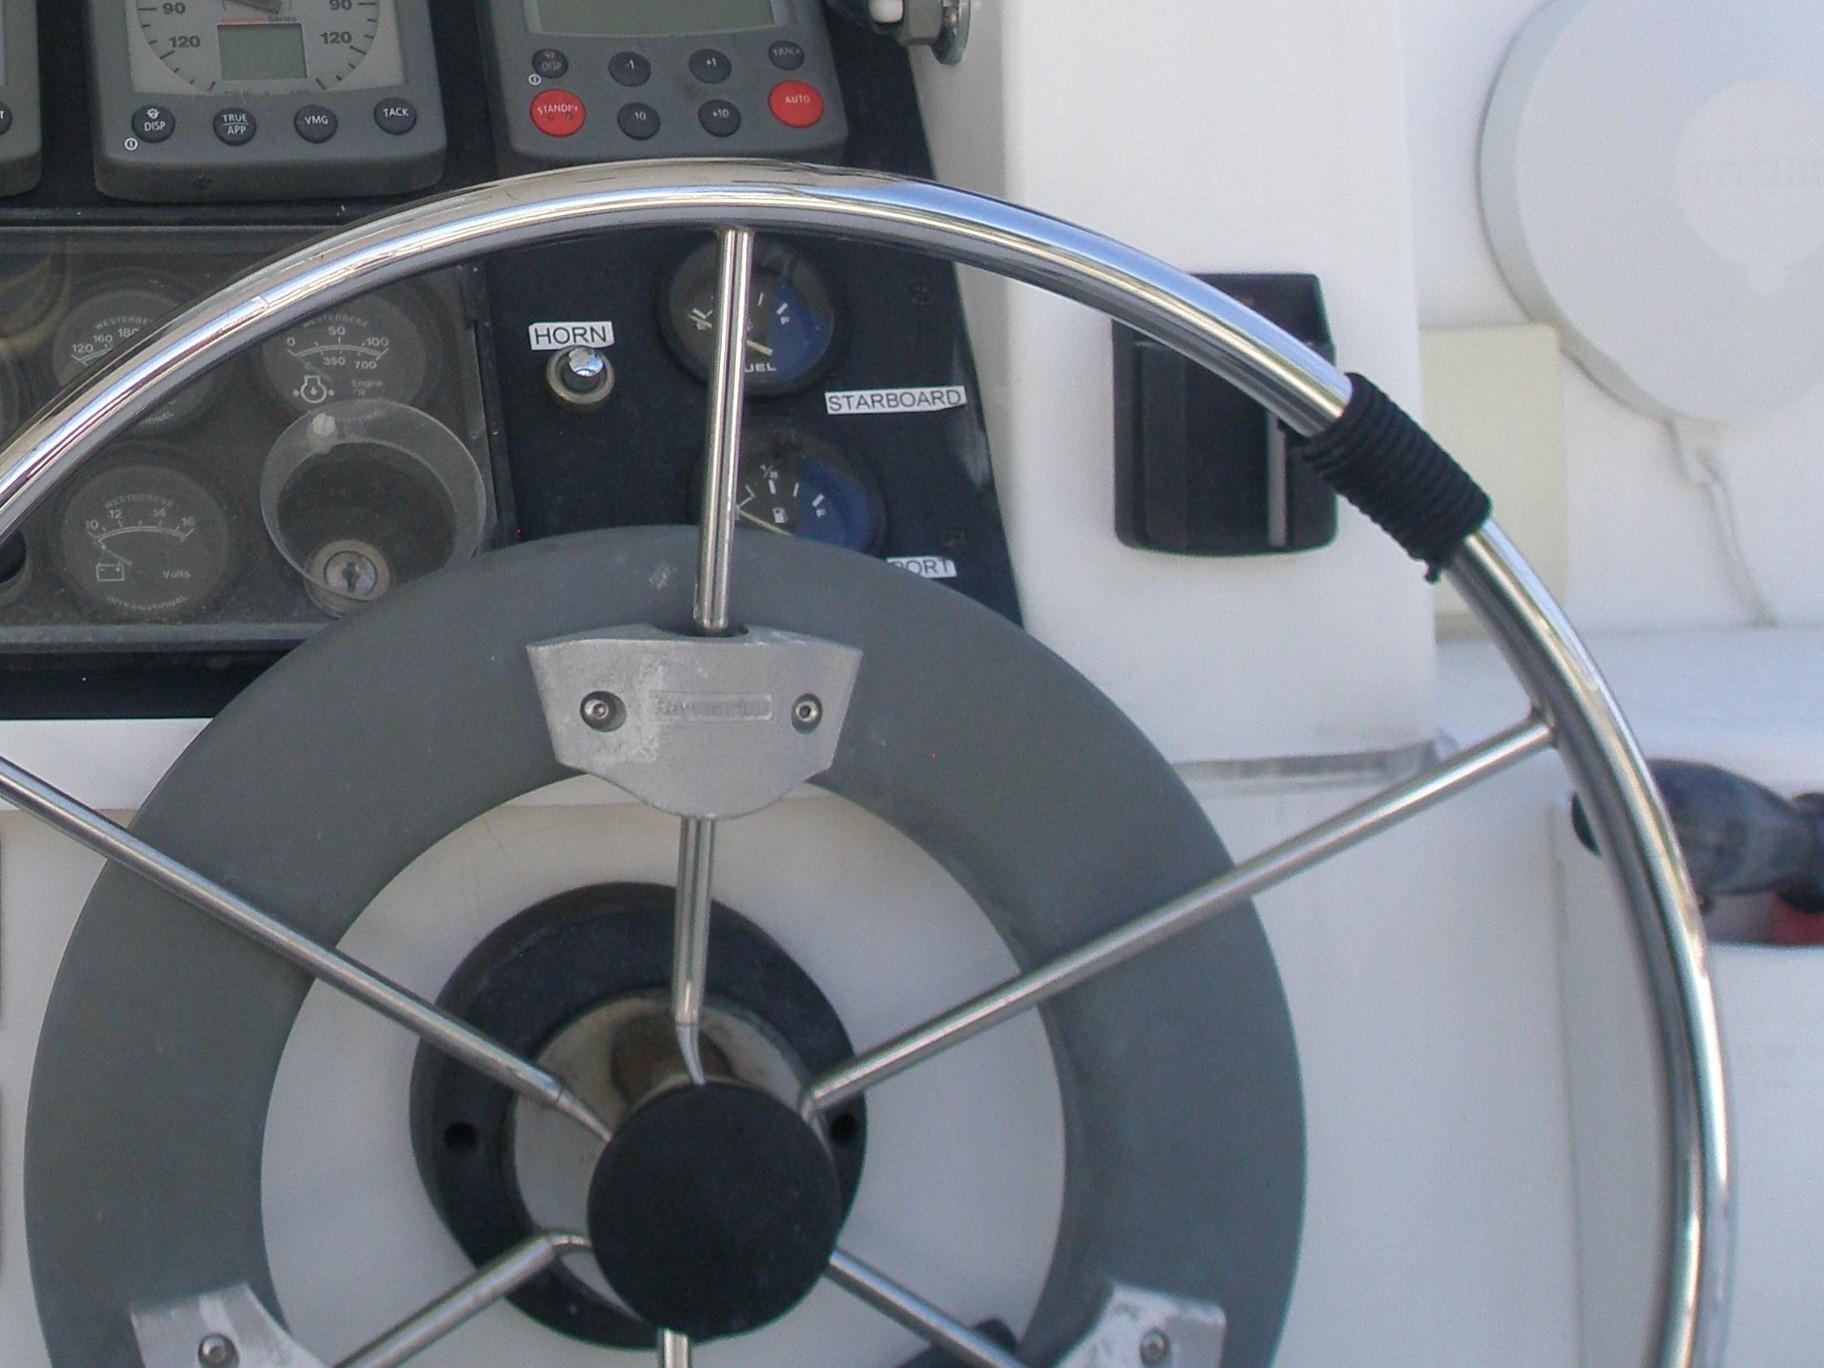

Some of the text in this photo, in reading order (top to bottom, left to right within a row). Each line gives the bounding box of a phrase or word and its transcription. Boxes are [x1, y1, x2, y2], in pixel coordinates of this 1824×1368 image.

[162, 2, 186, 14] 90
[168, 35, 201, 48] 120
[320, 31, 352, 44] 120
[785, 94, 810, 104] AUTO
[383, 107, 409, 117] TACK
[223, 114, 248, 123] TRUE
[304, 115, 329, 125] VMG
[144, 120, 166, 131] DISP
[227, 125, 247, 135] APP
[328, 325, 346, 336] 50
[535, 324, 608, 346] HORN
[93, 334, 113, 343] 160
[286, 336, 296, 347] 0
[366, 336, 389, 347] 100
[72, 343, 94, 353] 120
[323, 356, 346, 366] 350
[354, 359, 377, 370] 700
[829, 387, 962, 412] STARBOARD
[109, 509, 123, 519] 12
[84, 519, 100, 530] 10
